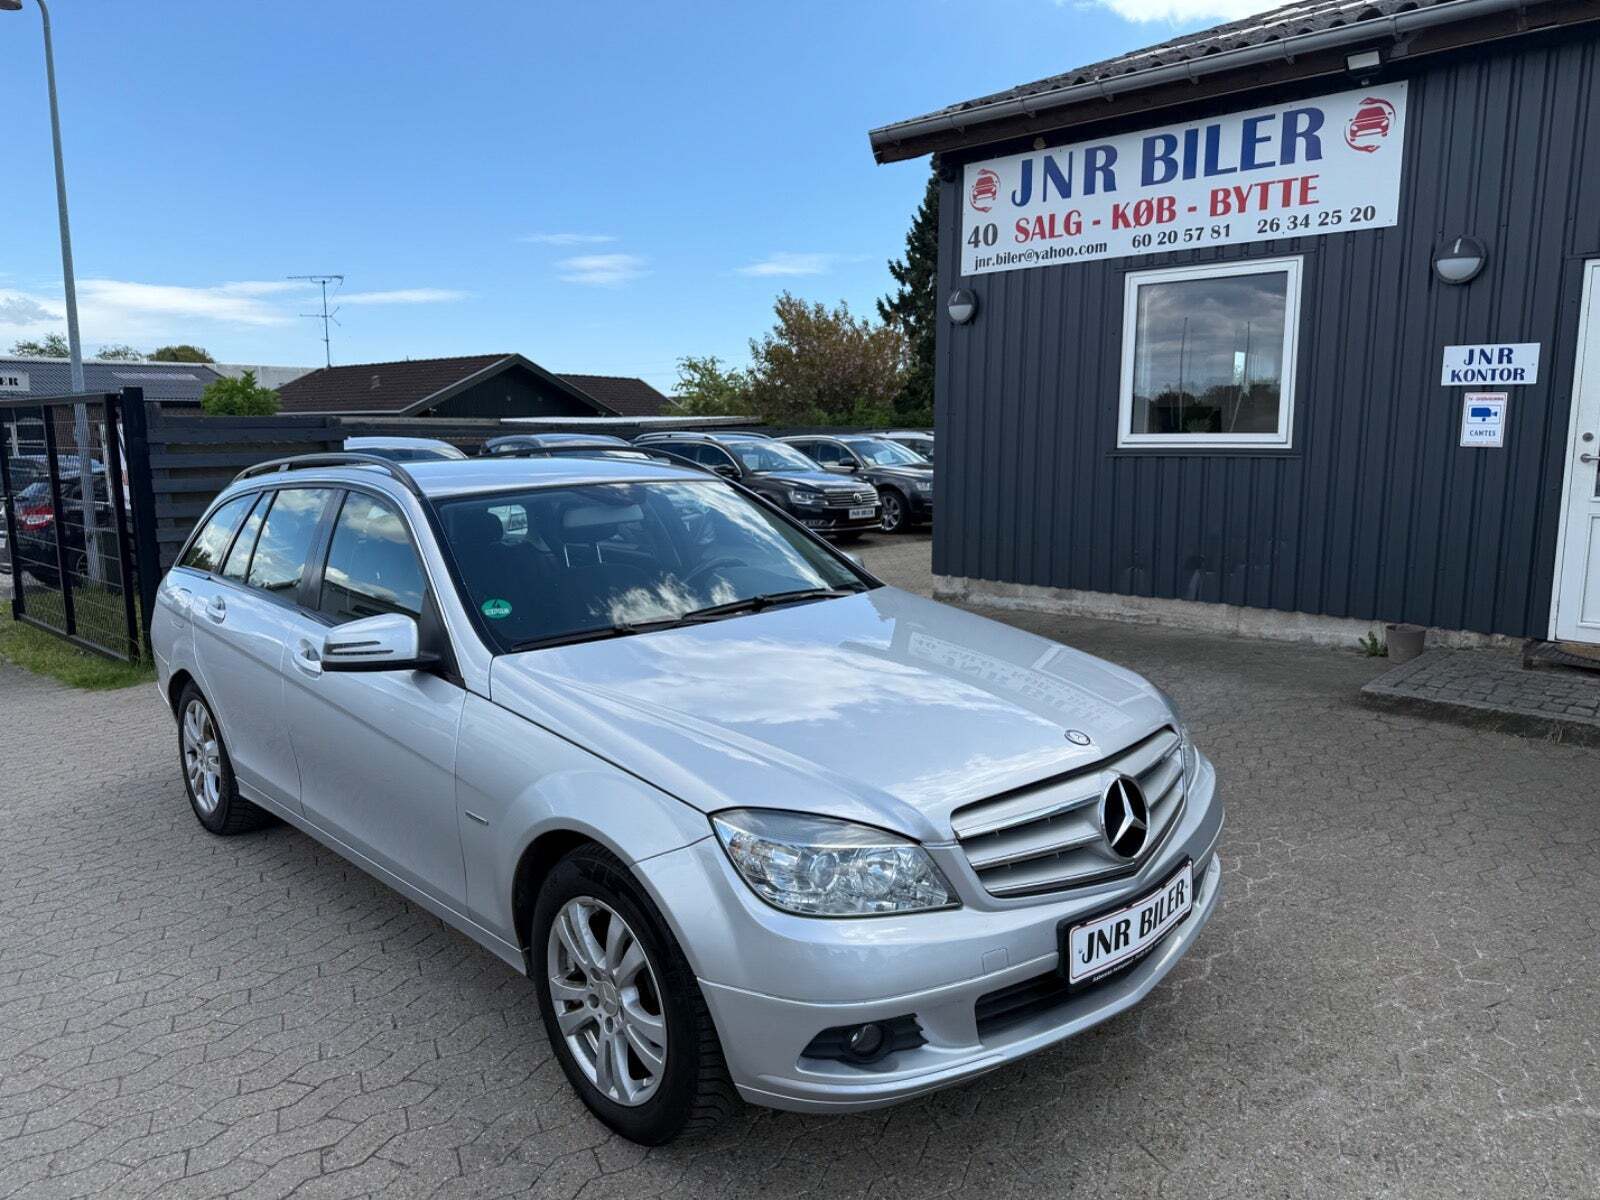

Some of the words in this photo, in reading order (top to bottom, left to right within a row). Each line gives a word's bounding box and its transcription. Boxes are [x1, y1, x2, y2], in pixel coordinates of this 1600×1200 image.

[1011, 144, 1118, 208] JNR
[1140, 107, 1325, 187] BILER
[1014, 209, 1082, 244] SALG
[1111, 195, 1177, 230] KØB
[1209, 174, 1320, 217] BYTTE
[1257, 216, 1281, 234] 26
[1286, 213, 1310, 231] 34
[1318, 209, 1342, 226] 25
[1350, 205, 1376, 223] 20
[967, 223, 998, 249] 40
[1132, 233, 1151, 249] 60
[1157, 230, 1178, 245] 20
[1183, 226, 1204, 243] 57
[1210, 223, 1231, 239] 81
[974, 242, 1108, 271] jnr.biler@yahoo.com
[1464, 347, 1514, 366] JNR
[1450, 367, 1526, 383] KONTOR
[1081, 918, 1131, 965] JNR
[1139, 878, 1185, 939] BILER
